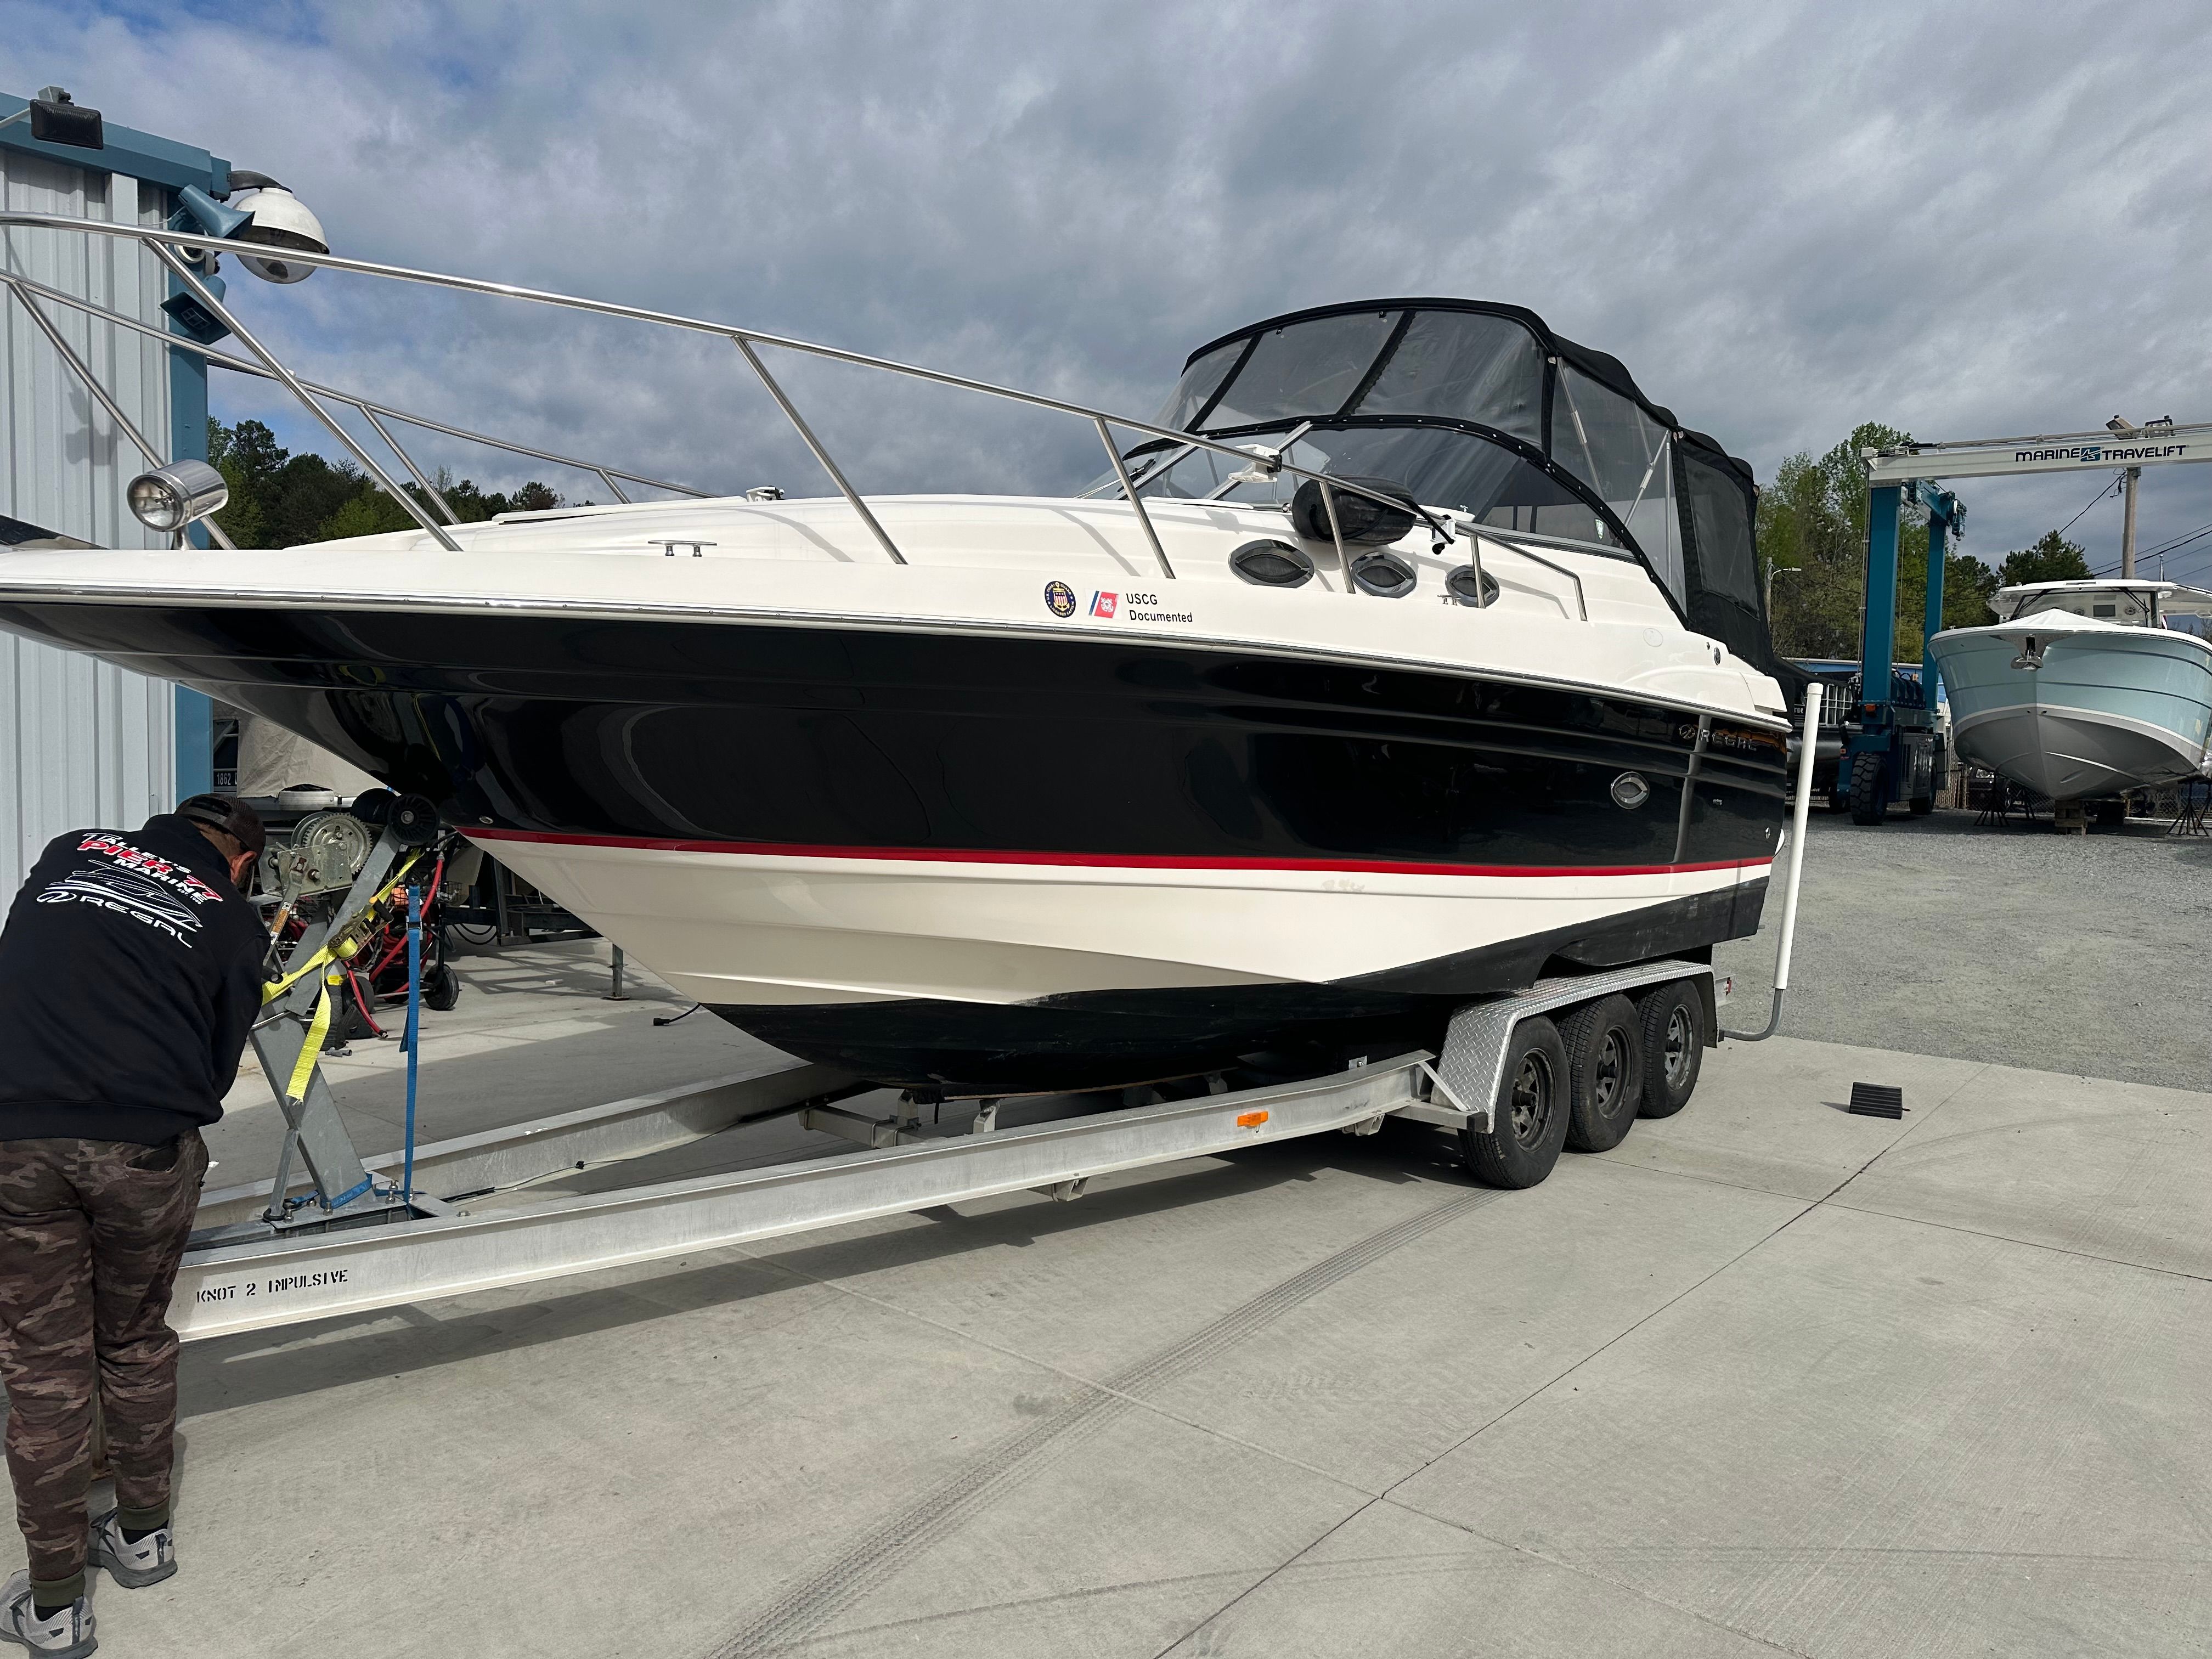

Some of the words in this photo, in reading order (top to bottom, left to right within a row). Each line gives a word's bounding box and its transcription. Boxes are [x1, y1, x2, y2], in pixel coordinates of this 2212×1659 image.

[2015, 448, 2080, 462] MARINE
[2101, 444, 2186, 460] TRAVELIFT
[1126, 593, 1158, 605] USCG
[1129, 610, 1193, 623] Documented
[1701, 729, 1757, 751] REGAL
[217, 772, 231, 786] 1862
[82, 833, 191, 873] TALLEY'S
[77, 840, 173, 874] PIER
[183, 874, 223, 901] 77
[113, 858, 208, 902] MARINE
[79, 896, 193, 949] REGAL
[196, 1285, 236, 1303] KNOT
[246, 1283, 256, 1296] 2
[268, 1269, 348, 1293] IMPULSIVE
